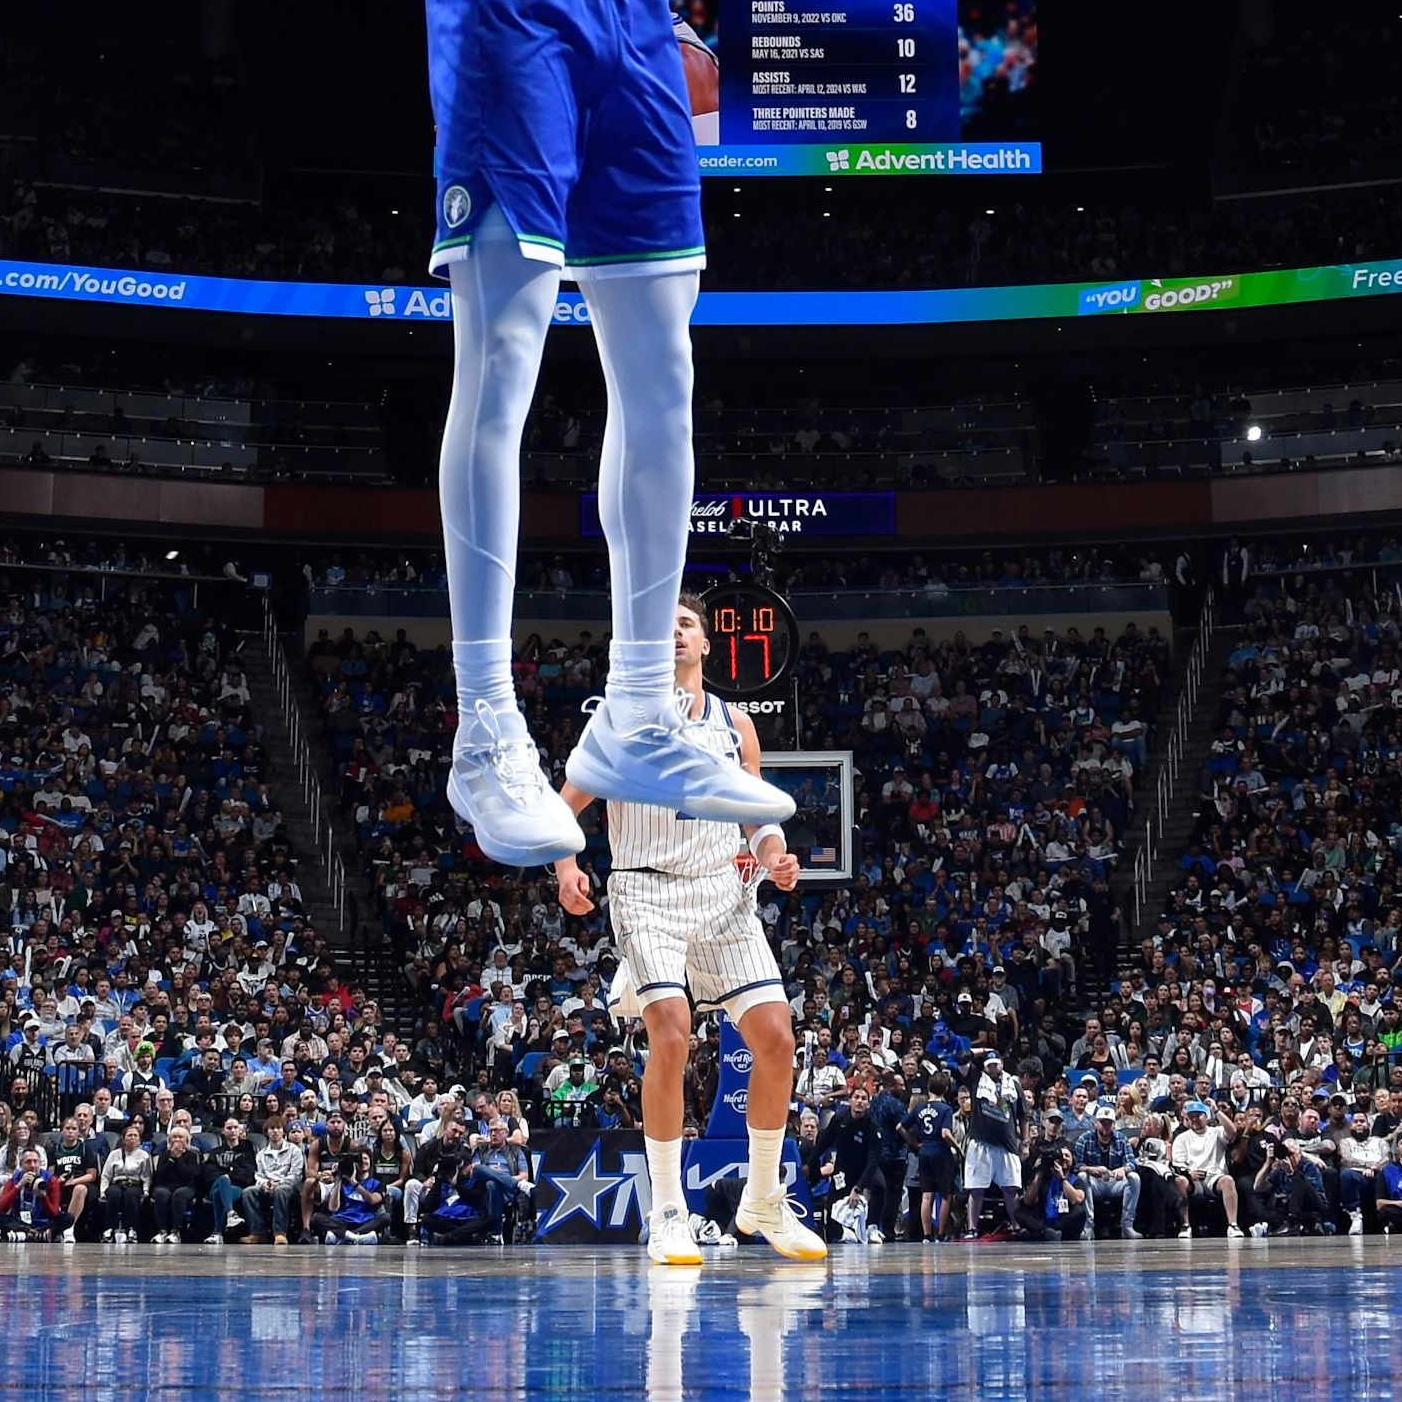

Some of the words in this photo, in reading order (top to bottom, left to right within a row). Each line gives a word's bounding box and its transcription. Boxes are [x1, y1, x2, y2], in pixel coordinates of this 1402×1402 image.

[752, 1, 785, 12] POINTS
[893, 3, 914, 22] 36
[752, 13, 792, 24] NOVEMBER
[801, 13, 819, 23] 2022
[820, 13, 831, 23] VS
[752, 36, 801, 48] REBOUNDS
[897, 38, 916, 58] 10
[752, 49, 769, 59] MAY
[781, 49, 798, 59] 2021
[799, 49, 809, 59] VS
[810, 49, 825, 58] SAS
[752, 72, 790, 83] ASSISTS
[899, 74, 916, 93] 12
[752, 84, 770, 94] MOST
[797, 84, 816, 94] APRIL
[843, 84, 851, 94] VS
[852, 84, 867, 93] WAS
[753, 108, 782, 119] THREE
[783, 108, 827, 119] POINTERS
[829, 107, 855, 119] MADE
[906, 110, 917, 129] 8
[753, 120, 771, 130] MOST
[798, 120, 817, 130] APRIL
[844, 120, 852, 130] VS
[699, 153, 778, 167] eader.com
[1145, 279, 1233, 311] GOOD?”
[690, 500, 728, 517] helob
[748, 499, 827, 517] ULTRA
[714, 607, 775, 633] 10:10
[730, 635, 771, 680] 17
[923, 1117, 934, 1135] 5
